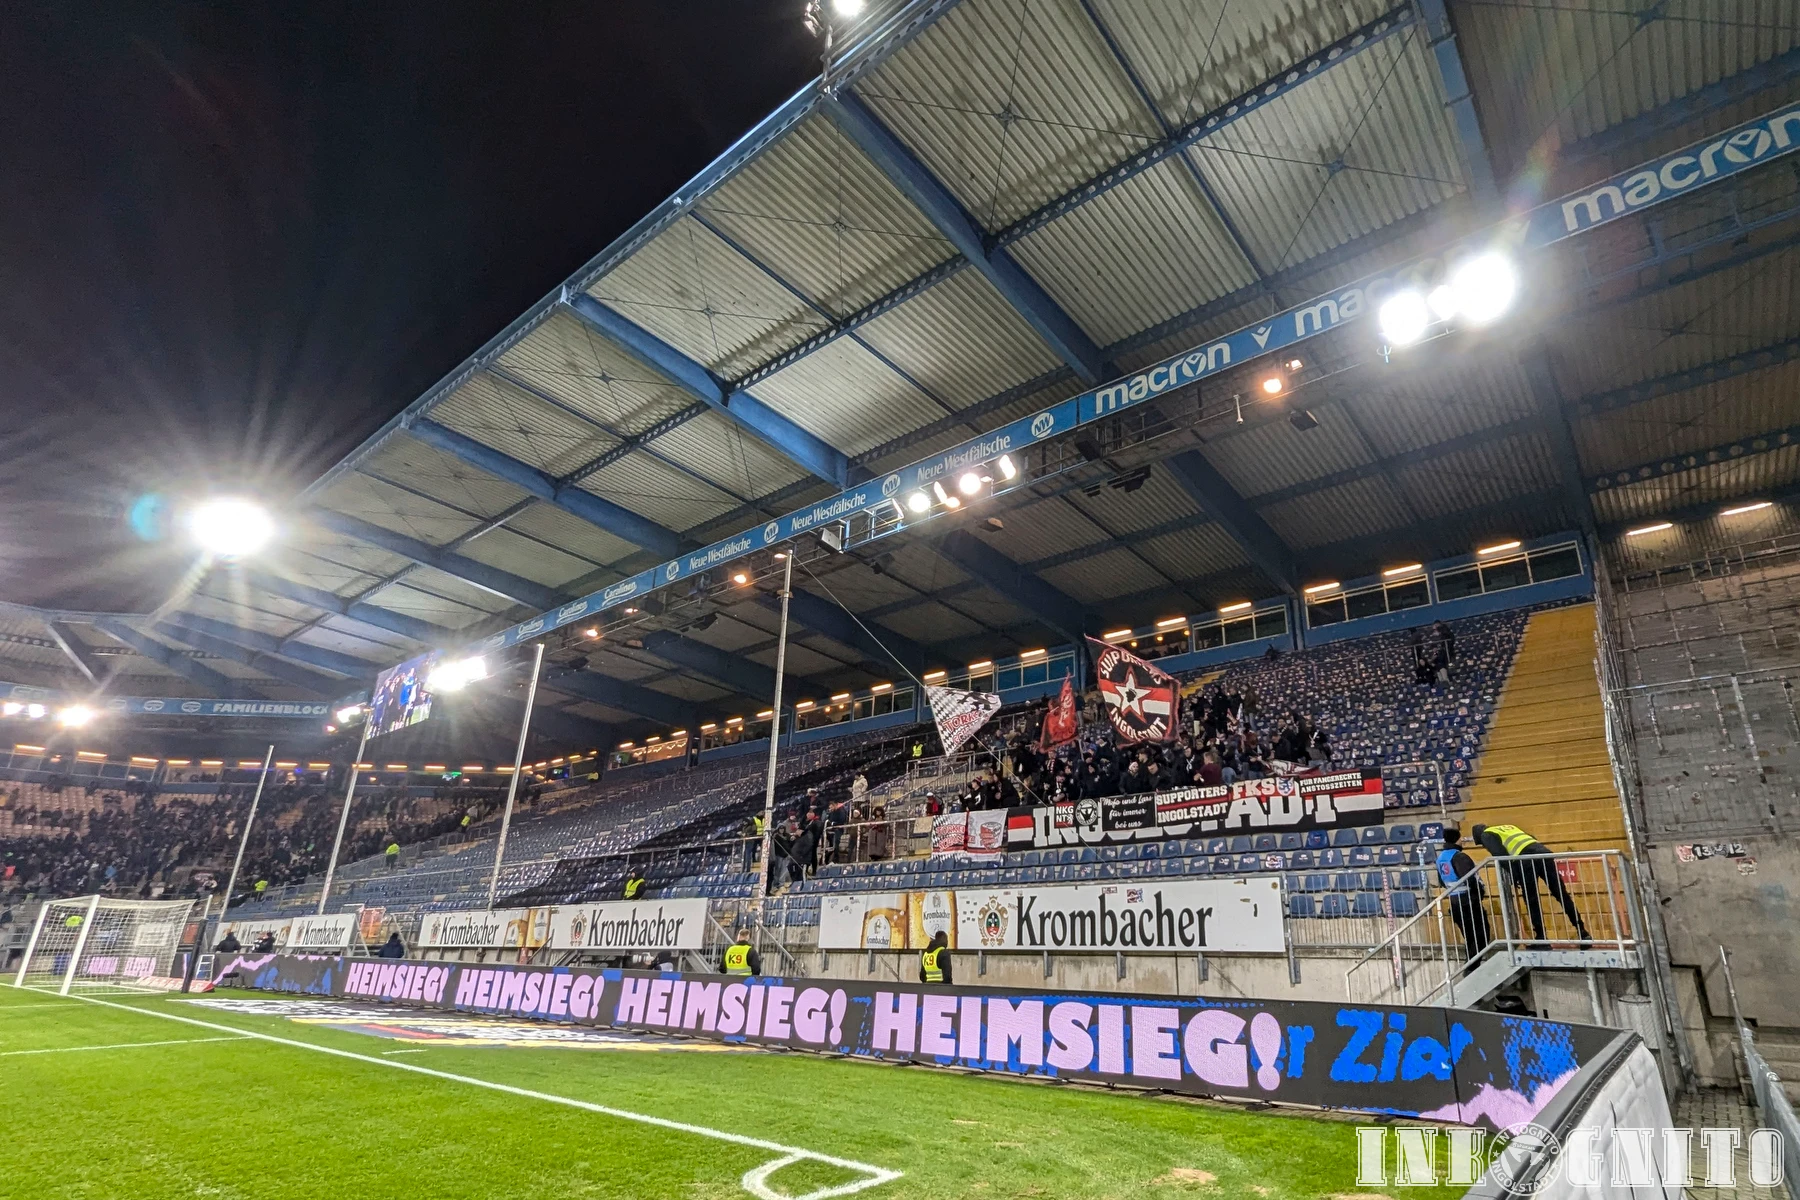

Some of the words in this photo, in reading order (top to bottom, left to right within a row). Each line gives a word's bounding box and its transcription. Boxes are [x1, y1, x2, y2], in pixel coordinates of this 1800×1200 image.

[1561, 110, 1800, 231] macron
[1095, 341, 1231, 414] macron
[917, 462, 943, 482] Neue
[944, 435, 1011, 470] Westfälische
[791, 512, 813, 531] Neue
[813, 491, 866, 522] Westfälische
[689, 552, 708, 570] Neue
[707, 538, 751, 562] Westfälische
[212, 703, 328, 715] FAMILIENBLOCK
[1110, 707, 1167, 741] INGOLSTADT
[1232, 777, 1275, 800] FKS
[1300, 780, 1363, 793] ANSTOSSZEITEN
[1313, 772, 1362, 785] FANGERECHTE
[1122, 796, 1137, 805] und
[1156, 785, 1228, 806] SUPPORTERS
[1056, 805, 1074, 815] NKG
[1109, 809, 1122, 820] für
[1122, 808, 1147, 817] immer
[1157, 802, 1229, 823] INGOLSTADT
[1115, 821, 1127, 829] bei
[922, 910, 952, 920] Krombacher
[1016, 891, 1213, 947] Krombacher
[302, 919, 346, 946] Krombacher
[440, 913, 500, 946] Krombacher
[588, 909, 684, 948] Krombacher
[729, 954, 743, 965] K9
[923, 955, 934, 966] K9
[344, 962, 449, 1003] HEIMSIEG!
[455, 968, 605, 1019] HEIMSIEG!
[617, 977, 847, 1046] HEIMSIEG!
[872, 990, 1281, 1091] HEIMSIEG!
